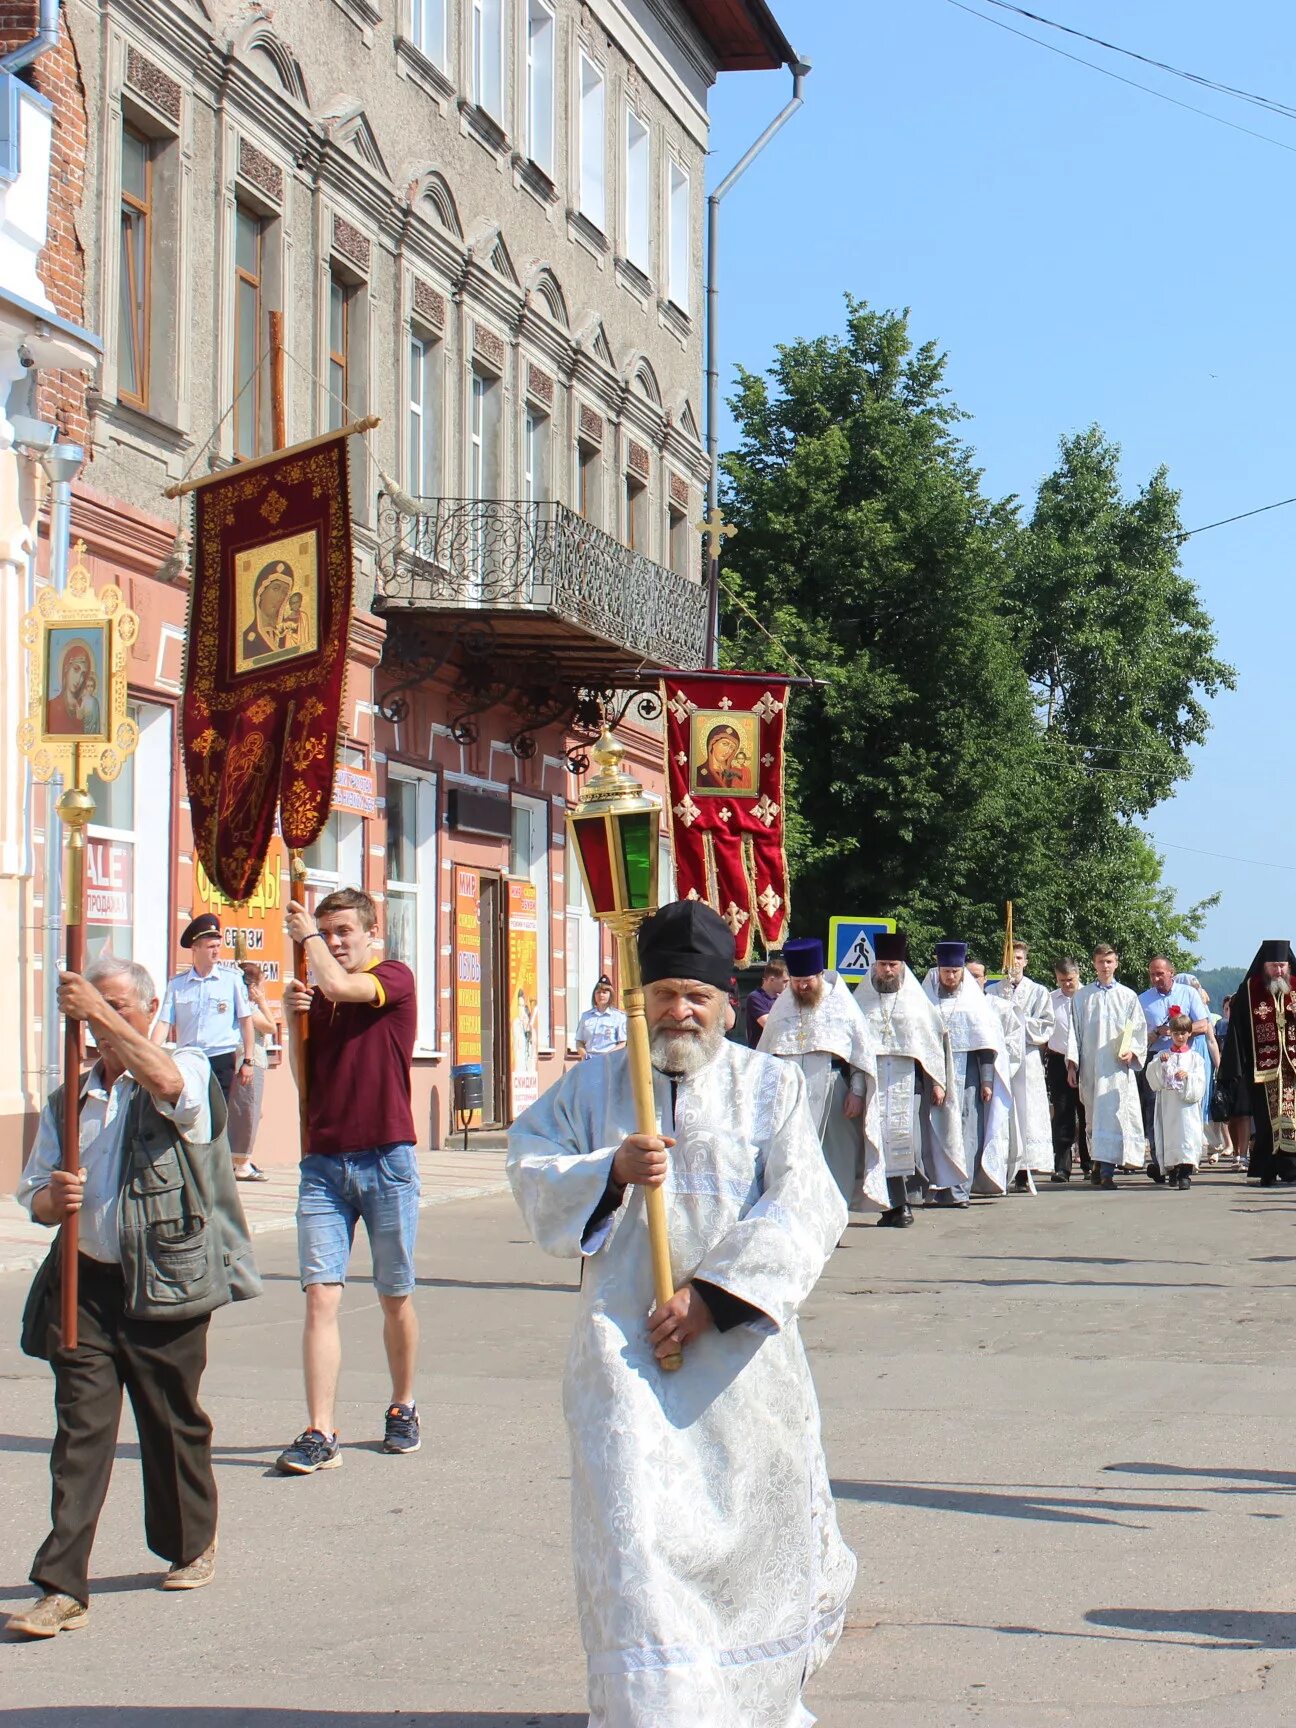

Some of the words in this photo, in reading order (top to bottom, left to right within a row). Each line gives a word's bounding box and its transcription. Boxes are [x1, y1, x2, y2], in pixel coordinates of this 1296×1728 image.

[87, 843, 123, 888] ALE
[460, 873, 476, 895] МИР
[459, 952, 481, 982] ОБУВЬ
